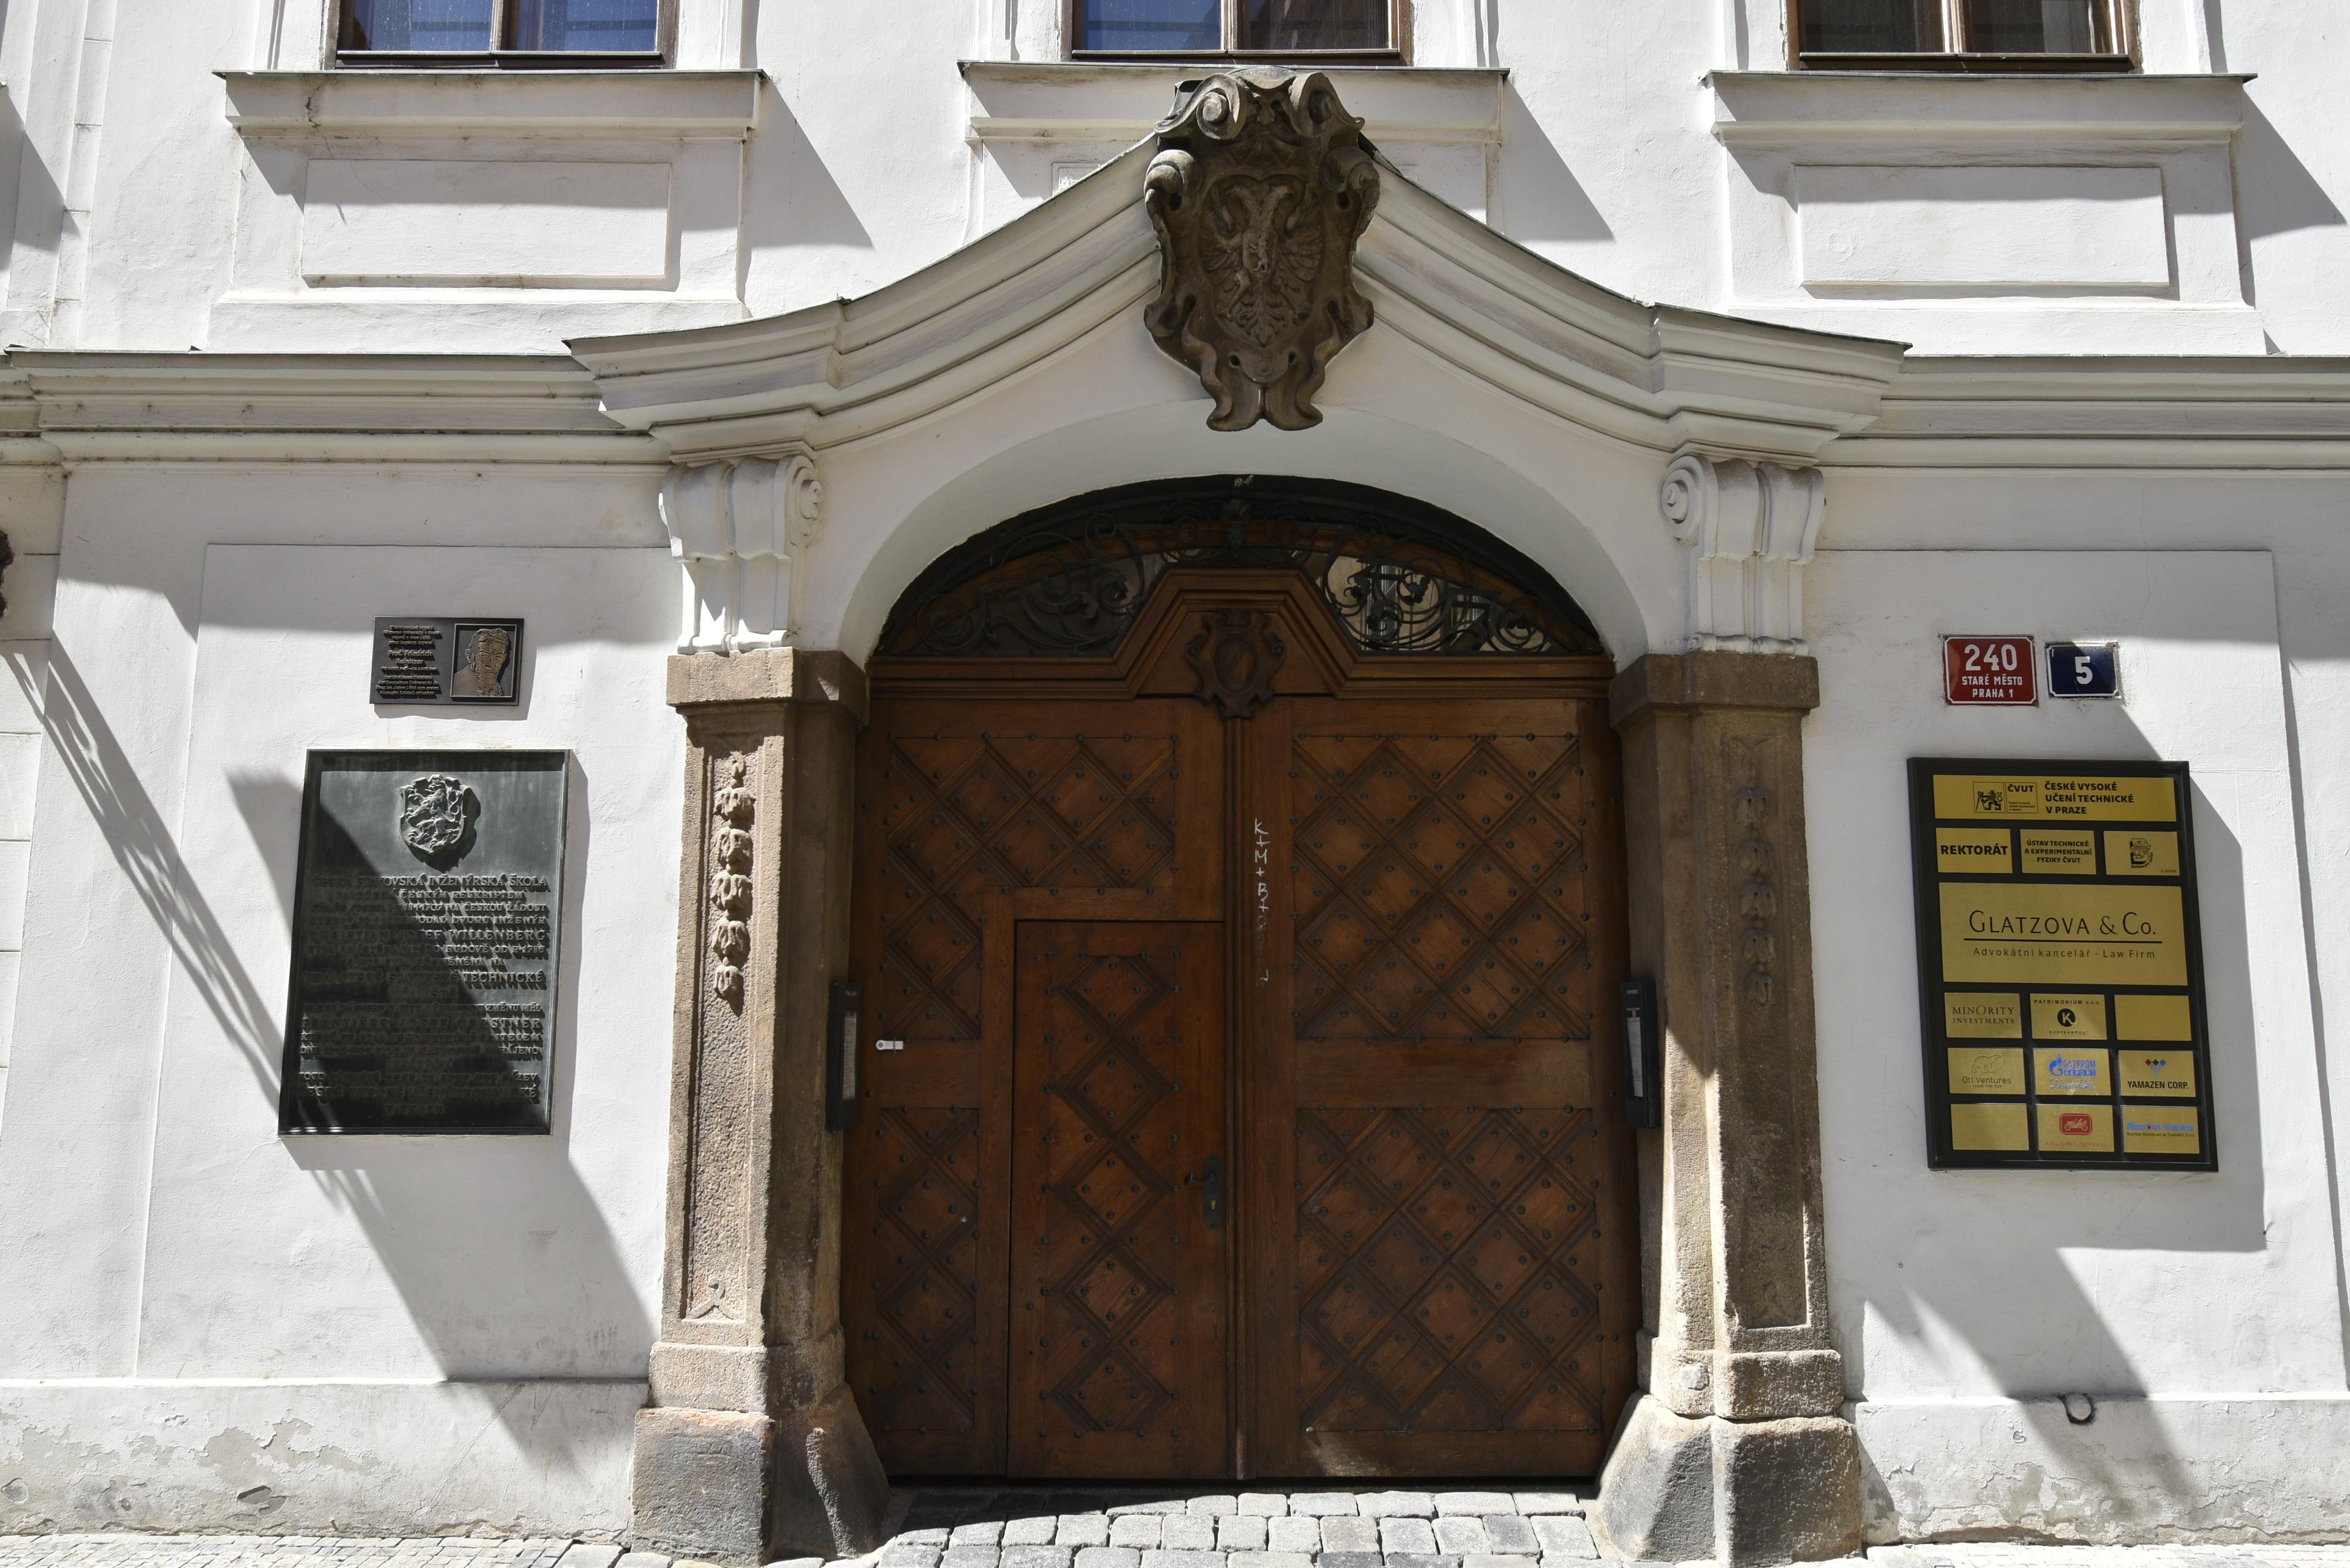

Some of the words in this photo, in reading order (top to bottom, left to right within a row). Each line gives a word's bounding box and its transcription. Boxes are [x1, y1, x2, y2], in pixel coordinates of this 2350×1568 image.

[1964, 644, 2017, 671] 240
[2074, 657, 2093, 684] 5
[1962, 674, 1989, 686] STARÉ
[1994, 674, 2022, 685] MĚSTO
[1972, 689, 2004, 698] PRAHA
[2009, 689, 2013, 698] 1
[2007, 783, 2034, 793] ČVUT
[2044, 781, 2076, 790] ČESKÉ
[2077, 782, 2117, 791] VYSOKÉ
[2045, 793, 2076, 802] UČENÍ
[2077, 794, 2134, 803] TECHNICKÉ
[1941, 843, 2007, 855] REKTORÁT
[428, 873, 505, 887] INŽENÝRSKÁ
[510, 873, 547, 887] ŠKOLA
[400, 888, 446, 899] ČESKÝM
[464, 902, 503, 912] ČESKOU
[507, 901, 547, 912] ŽÁDOST
[452, 916, 489, 924] DVORU
[495, 914, 546, 924] INŽENÝR
[2100, 915, 2118, 935] &
[448, 930, 545, 941] WILLENBERG
[446, 944, 489, 953] BUDOVĚ
[1973, 947, 2034, 957] Advokátní
[2039, 948, 2092, 958] kancelář
[2103, 949, 2124, 958] Law
[2129, 949, 2155, 958] Firm
[462, 970, 543, 982] TECHNICKÉ
[486, 1002, 519, 1012] ZMĚNU
[521, 1002, 541, 1012] MĚL
[1952, 1005, 2014, 1015] MINORITY
[2063, 1059, 2096, 1069] GAZPROM
[1962, 1076, 1974, 1084] Ott
[1976, 1076, 2012, 1084] Ventures
